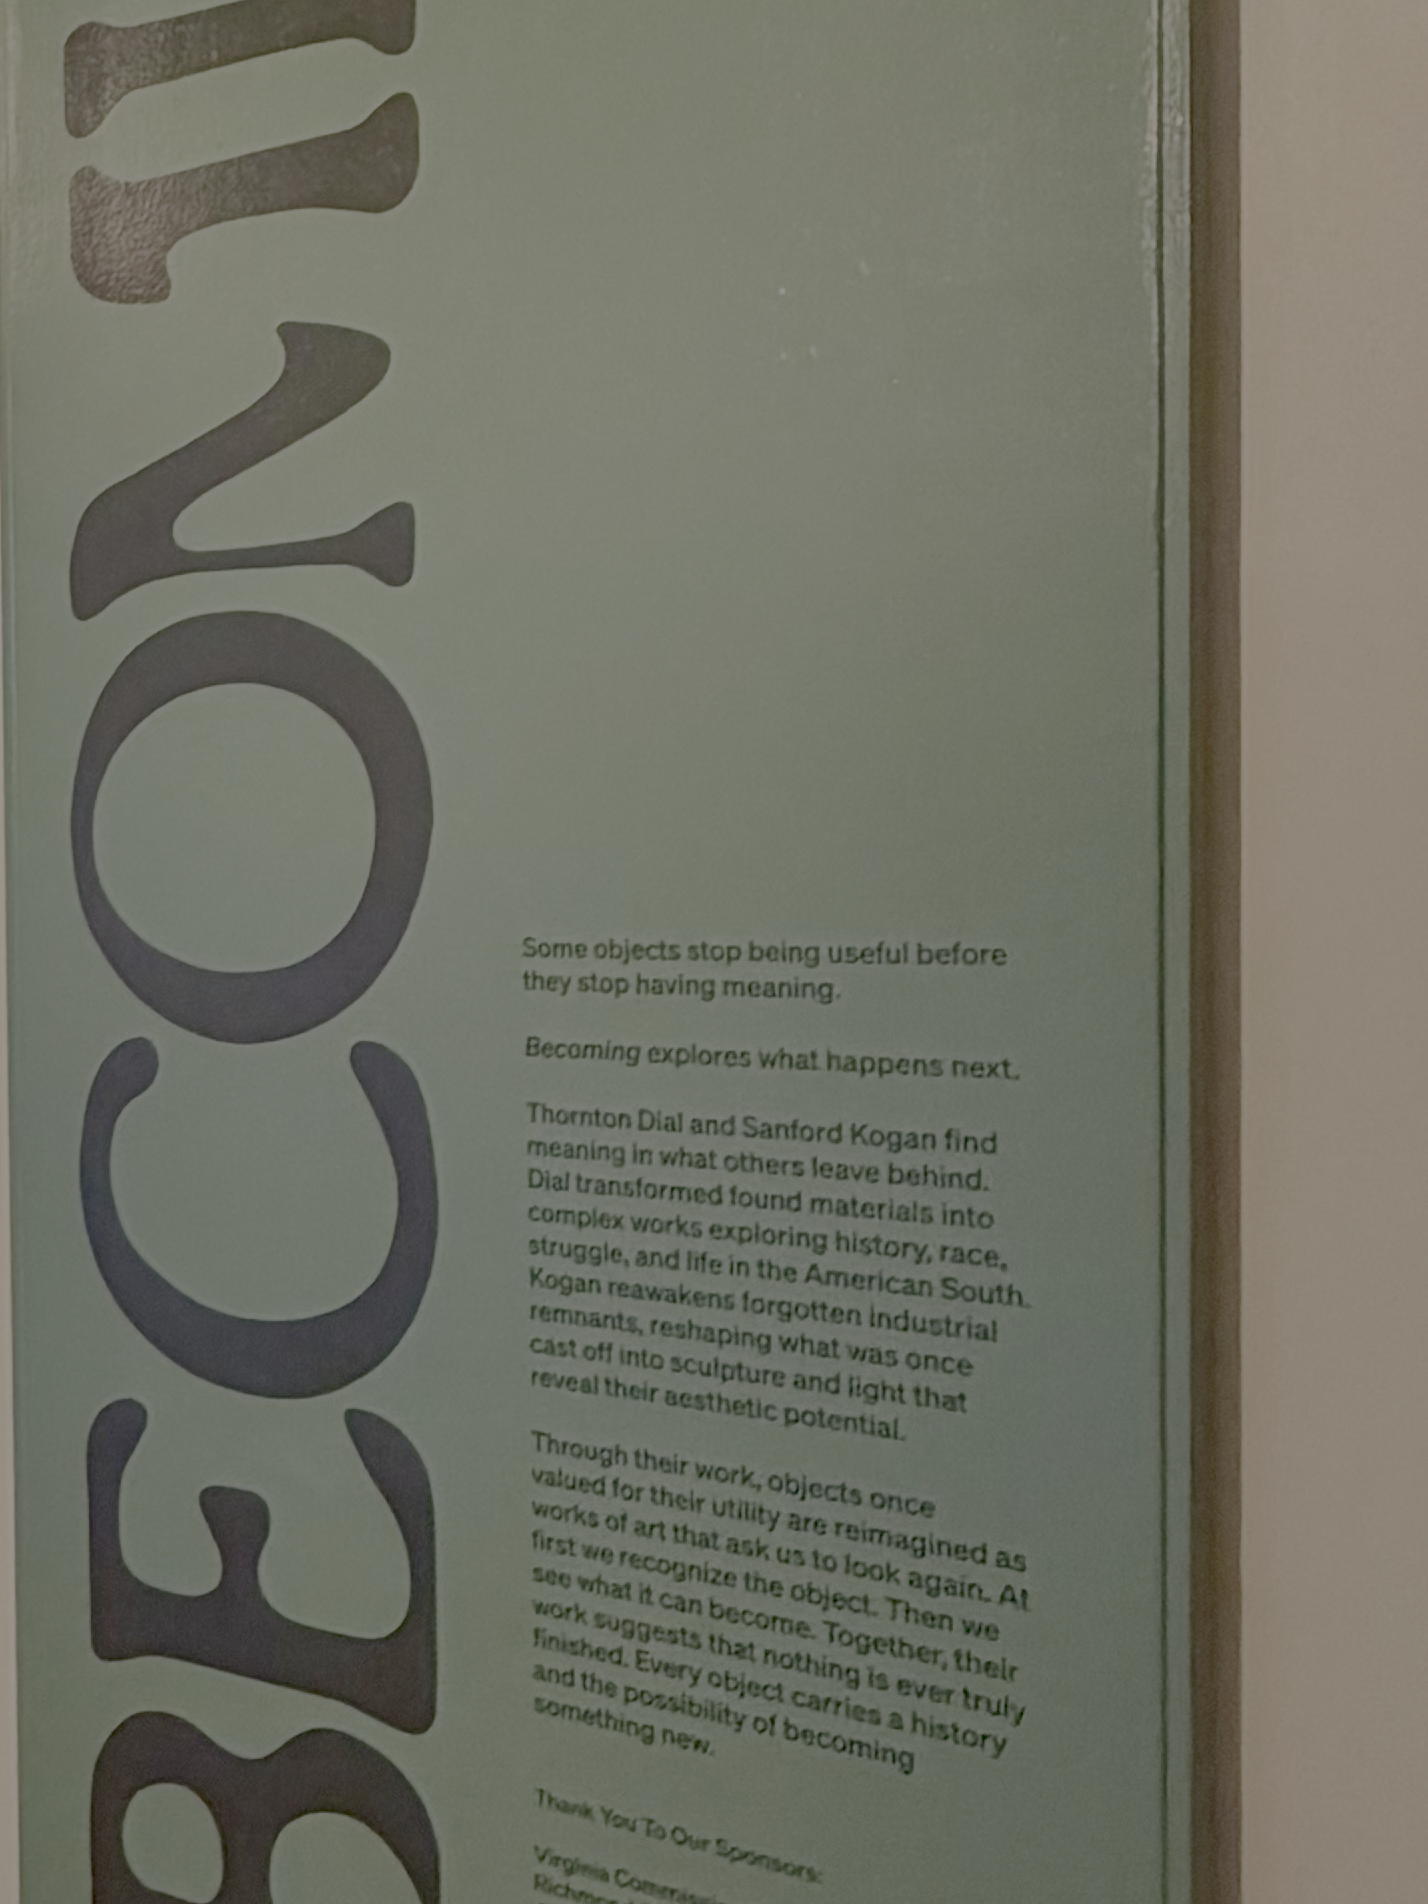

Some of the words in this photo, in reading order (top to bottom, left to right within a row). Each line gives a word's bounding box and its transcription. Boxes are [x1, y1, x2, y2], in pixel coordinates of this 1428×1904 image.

[522, 937, 588, 958] Some
[593, 939, 681, 964] objects
[688, 942, 742, 965] stop
[748, 941, 820, 967] being
[828, 941, 908, 965] useful
[917, 941, 1007, 966] before
[523, 971, 571, 996] they
[577, 973, 630, 998] stop
[636, 974, 715, 1002] having
[722, 977, 840, 1005] meaning.
[525, 1036, 641, 1067] Becoming
[647, 1044, 751, 1069] explores
[758, 1048, 820, 1070] what
[827, 1049, 943, 1078] happens
[952, 1059, 1020, 1080] next.
[527, 1102, 632, 1129] Thornton
[637, 1109, 683, 1133] Dial
[690, 1115, 736, 1137] and
[742, 1115, 843, 1145] Sanford
[850, 1123, 936, 1152] Kogan
[945, 1128, 997, 1155] find
[527, 1140, 625, 1168] meaning
[632, 1143, 652, 1165] in
[659, 1147, 717, 1170] what
[724, 1152, 805, 1177] others
[811, 1156, 879, 1184] leave
[888, 1162, 990, 1191] behind.
[528, 1168, 570, 1192] Dial
[576, 1174, 723, 1206] transformed
[729, 1185, 802, 1213] found
[810, 1196, 934, 1224] materials
[942, 1203, 994, 1229] into
[528, 1205, 624, 1230] complex
[630, 1215, 702, 1238] works
[709, 1222, 828, 1256] exploring
[836, 1230, 932, 1265] history,
[940, 1245, 1007, 1272] race,
[529, 1236, 629, 1268] struggle,
[635, 1249, 679, 1271] and
[687, 1250, 722, 1275] life
[729, 1255, 750, 1277] in
[757, 1259, 797, 1283] the
[804, 1263, 933, 1297] American
[941, 1277, 1031, 1308] South.
[529, 1267, 601, 1297] Kogan
[608, 1282, 735, 1311] reawakens
[742, 1290, 862, 1326] forgotten
[869, 1304, 997, 1343] industrial
[529, 1305, 643, 1336] remnants,
[650, 1319, 771, 1355] reshaping
[779, 1333, 840, 1359] what
[846, 1345, 899, 1367] was
[905, 1352, 974, 1377] once
[529, 1338, 576, 1359] cast
[582, 1342, 613, 1364] off
[619, 1347, 664, 1370] into
[671, 1356, 785, 1388] sculpture
[793, 1372, 840, 1395] and
[848, 1375, 906, 1405] light
[913, 1385, 966, 1414] that
[531, 1371, 599, 1395] reveal
[604, 1377, 659, 1403] their
[664, 1390, 777, 1421] aesthetic
[783, 1407, 905, 1441] potential.
[531, 1430, 628, 1469] Through
[634, 1449, 689, 1475] their
[695, 1463, 761, 1492] work,
[767, 1473, 863, 1506] objects
[870, 1492, 935, 1519] once
[532, 1468, 606, 1497] valued
[612, 1477, 645, 1502] for
[650, 1486, 705, 1513] their
[712, 1499, 780, 1532] utility
[787, 1513, 827, 1536] are
[835, 1522, 987, 1565] reimagined
[996, 1551, 1027, 1573] as
[532, 1501, 599, 1528] works
[605, 1512, 628, 1533] of
[634, 1520, 665, 1542] art
[673, 1524, 720, 1551] that
[726, 1537, 769, 1561] ask
[776, 1547, 806, 1566] us
[812, 1549, 837, 1573] to
[844, 1553, 900, 1585] look
[908, 1571, 992, 1603] again.
[998, 1585, 1029, 1612] At
[532, 1529, 576, 1557] first
[582, 1544, 613, 1565] we
[619, 1551, 737, 1588] recognize
[744, 1572, 784, 1598] the
[790, 1582, 878, 1617] object.
[884, 1597, 953, 1632] Then
[962, 1619, 1000, 1641] we
[533, 1567, 571, 1589] see
[577, 1574, 631, 1601] what
[639, 1582, 653, 1606] it
[659, 1593, 702, 1615] can
[709, 1597, 816, 1639] become.
[822, 1620, 947, 1671] Together,
[953, 1649, 1018, 1682] their
[532, 1600, 587, 1625] work
[594, 1612, 702, 1650] suggests
[709, 1633, 756, 1663] that
[763, 1649, 860, 1691] nothing
[867, 1666, 890, 1691] is
[897, 1679, 955, 1705] ever
[963, 1687, 1025, 1725] truly
[533, 1627, 628, 1667] finished.
[635, 1649, 702, 1688] Every
[708, 1670, 784, 1703] object
[791, 1691, 881, 1726] carries
[887, 1712, 904, 1731] a
[911, 1711, 1007, 1757] history
[533, 1664, 575, 1688] and
[581, 1671, 617, 1698] the
[624, 1685, 747, 1733] possibility
[753, 1714, 777, 1737] of
[783, 1717, 914, 1773] becoming
[534, 1697, 655, 1744] something
[662, 1728, 714, 1756] new.
[535, 1788, 594, 1821] Thank
[601, 1806, 637, 1833] You
[641, 1818, 667, 1841] To
[671, 1826, 711, 1851] Our
[533, 1845, 609, 1883] Virginia
